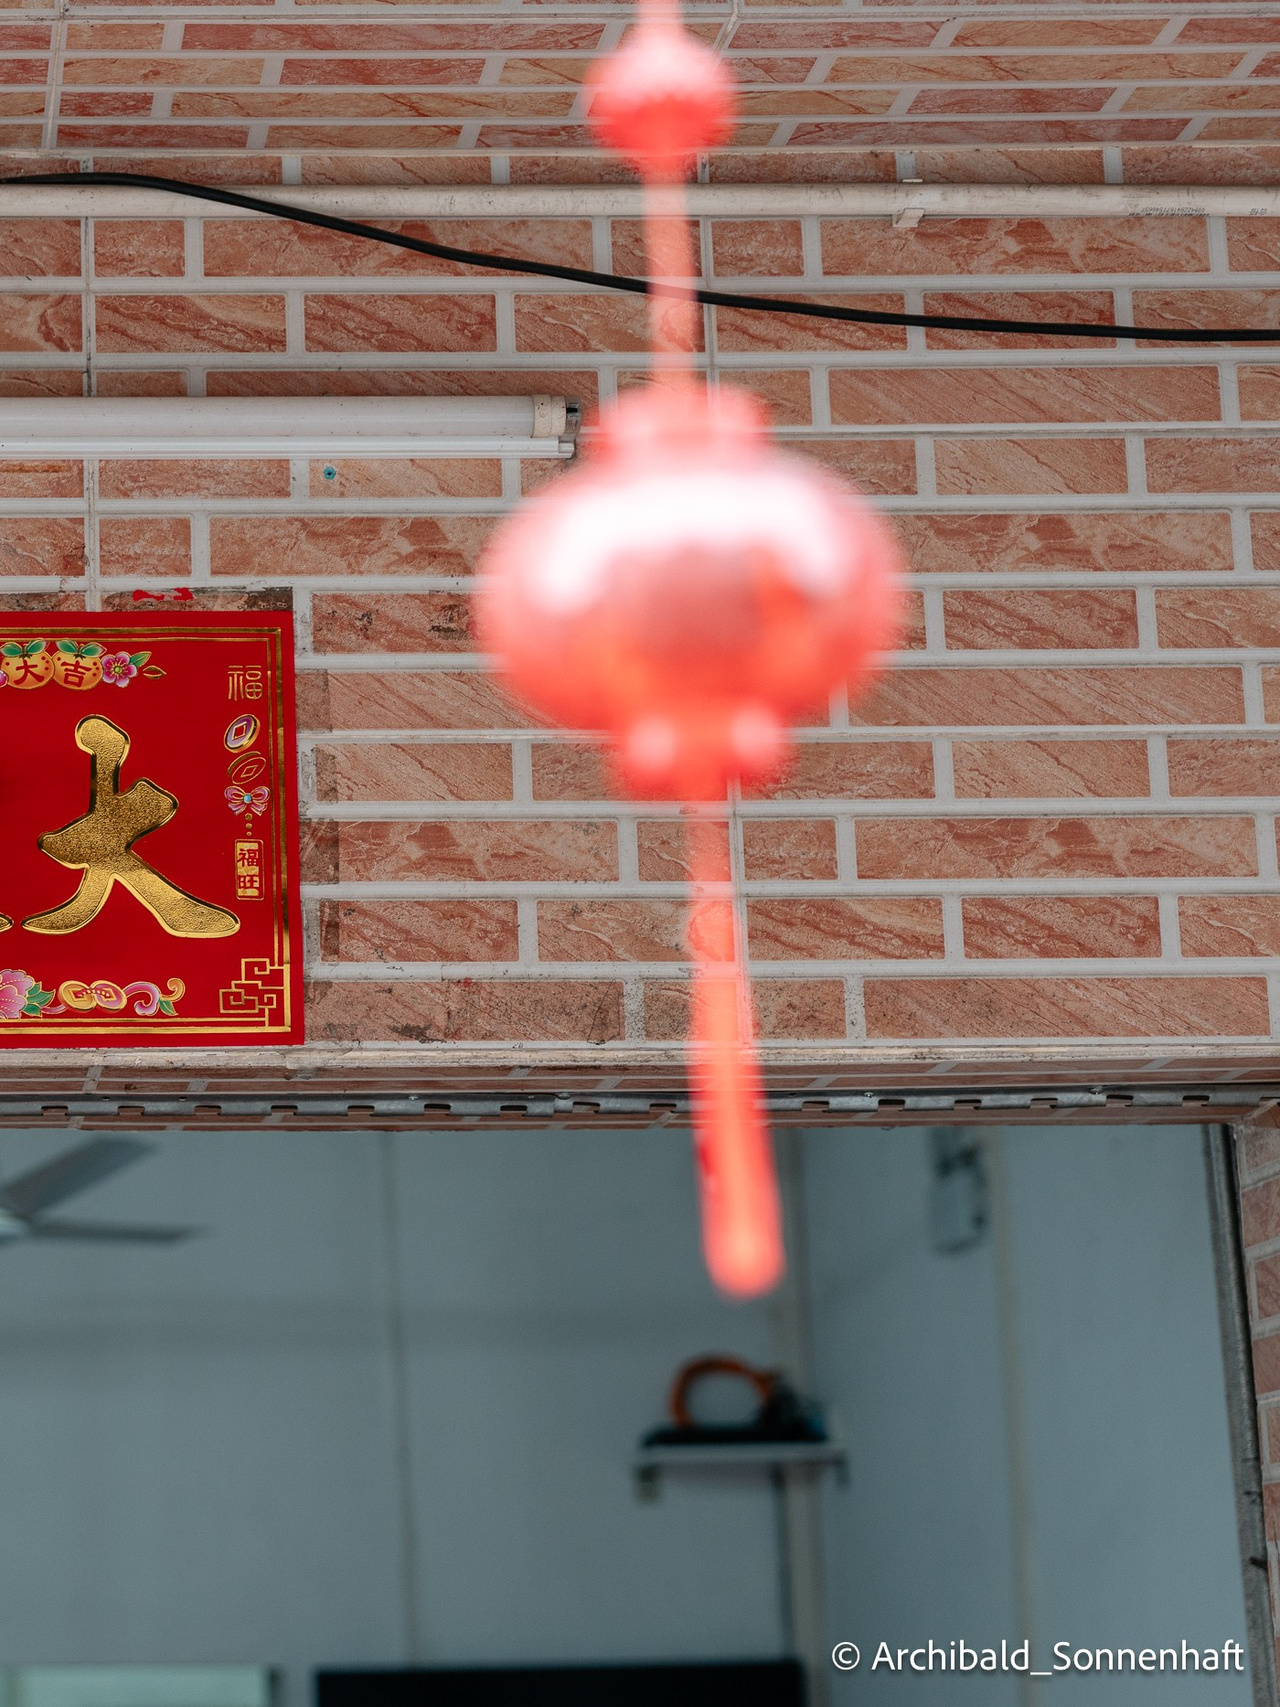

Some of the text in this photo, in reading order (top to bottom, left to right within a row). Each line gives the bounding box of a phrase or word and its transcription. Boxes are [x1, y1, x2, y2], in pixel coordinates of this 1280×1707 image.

[13, 659, 93, 688] 大吉
[227, 664, 263, 701] 福
[237, 849, 261, 892] 福旺
